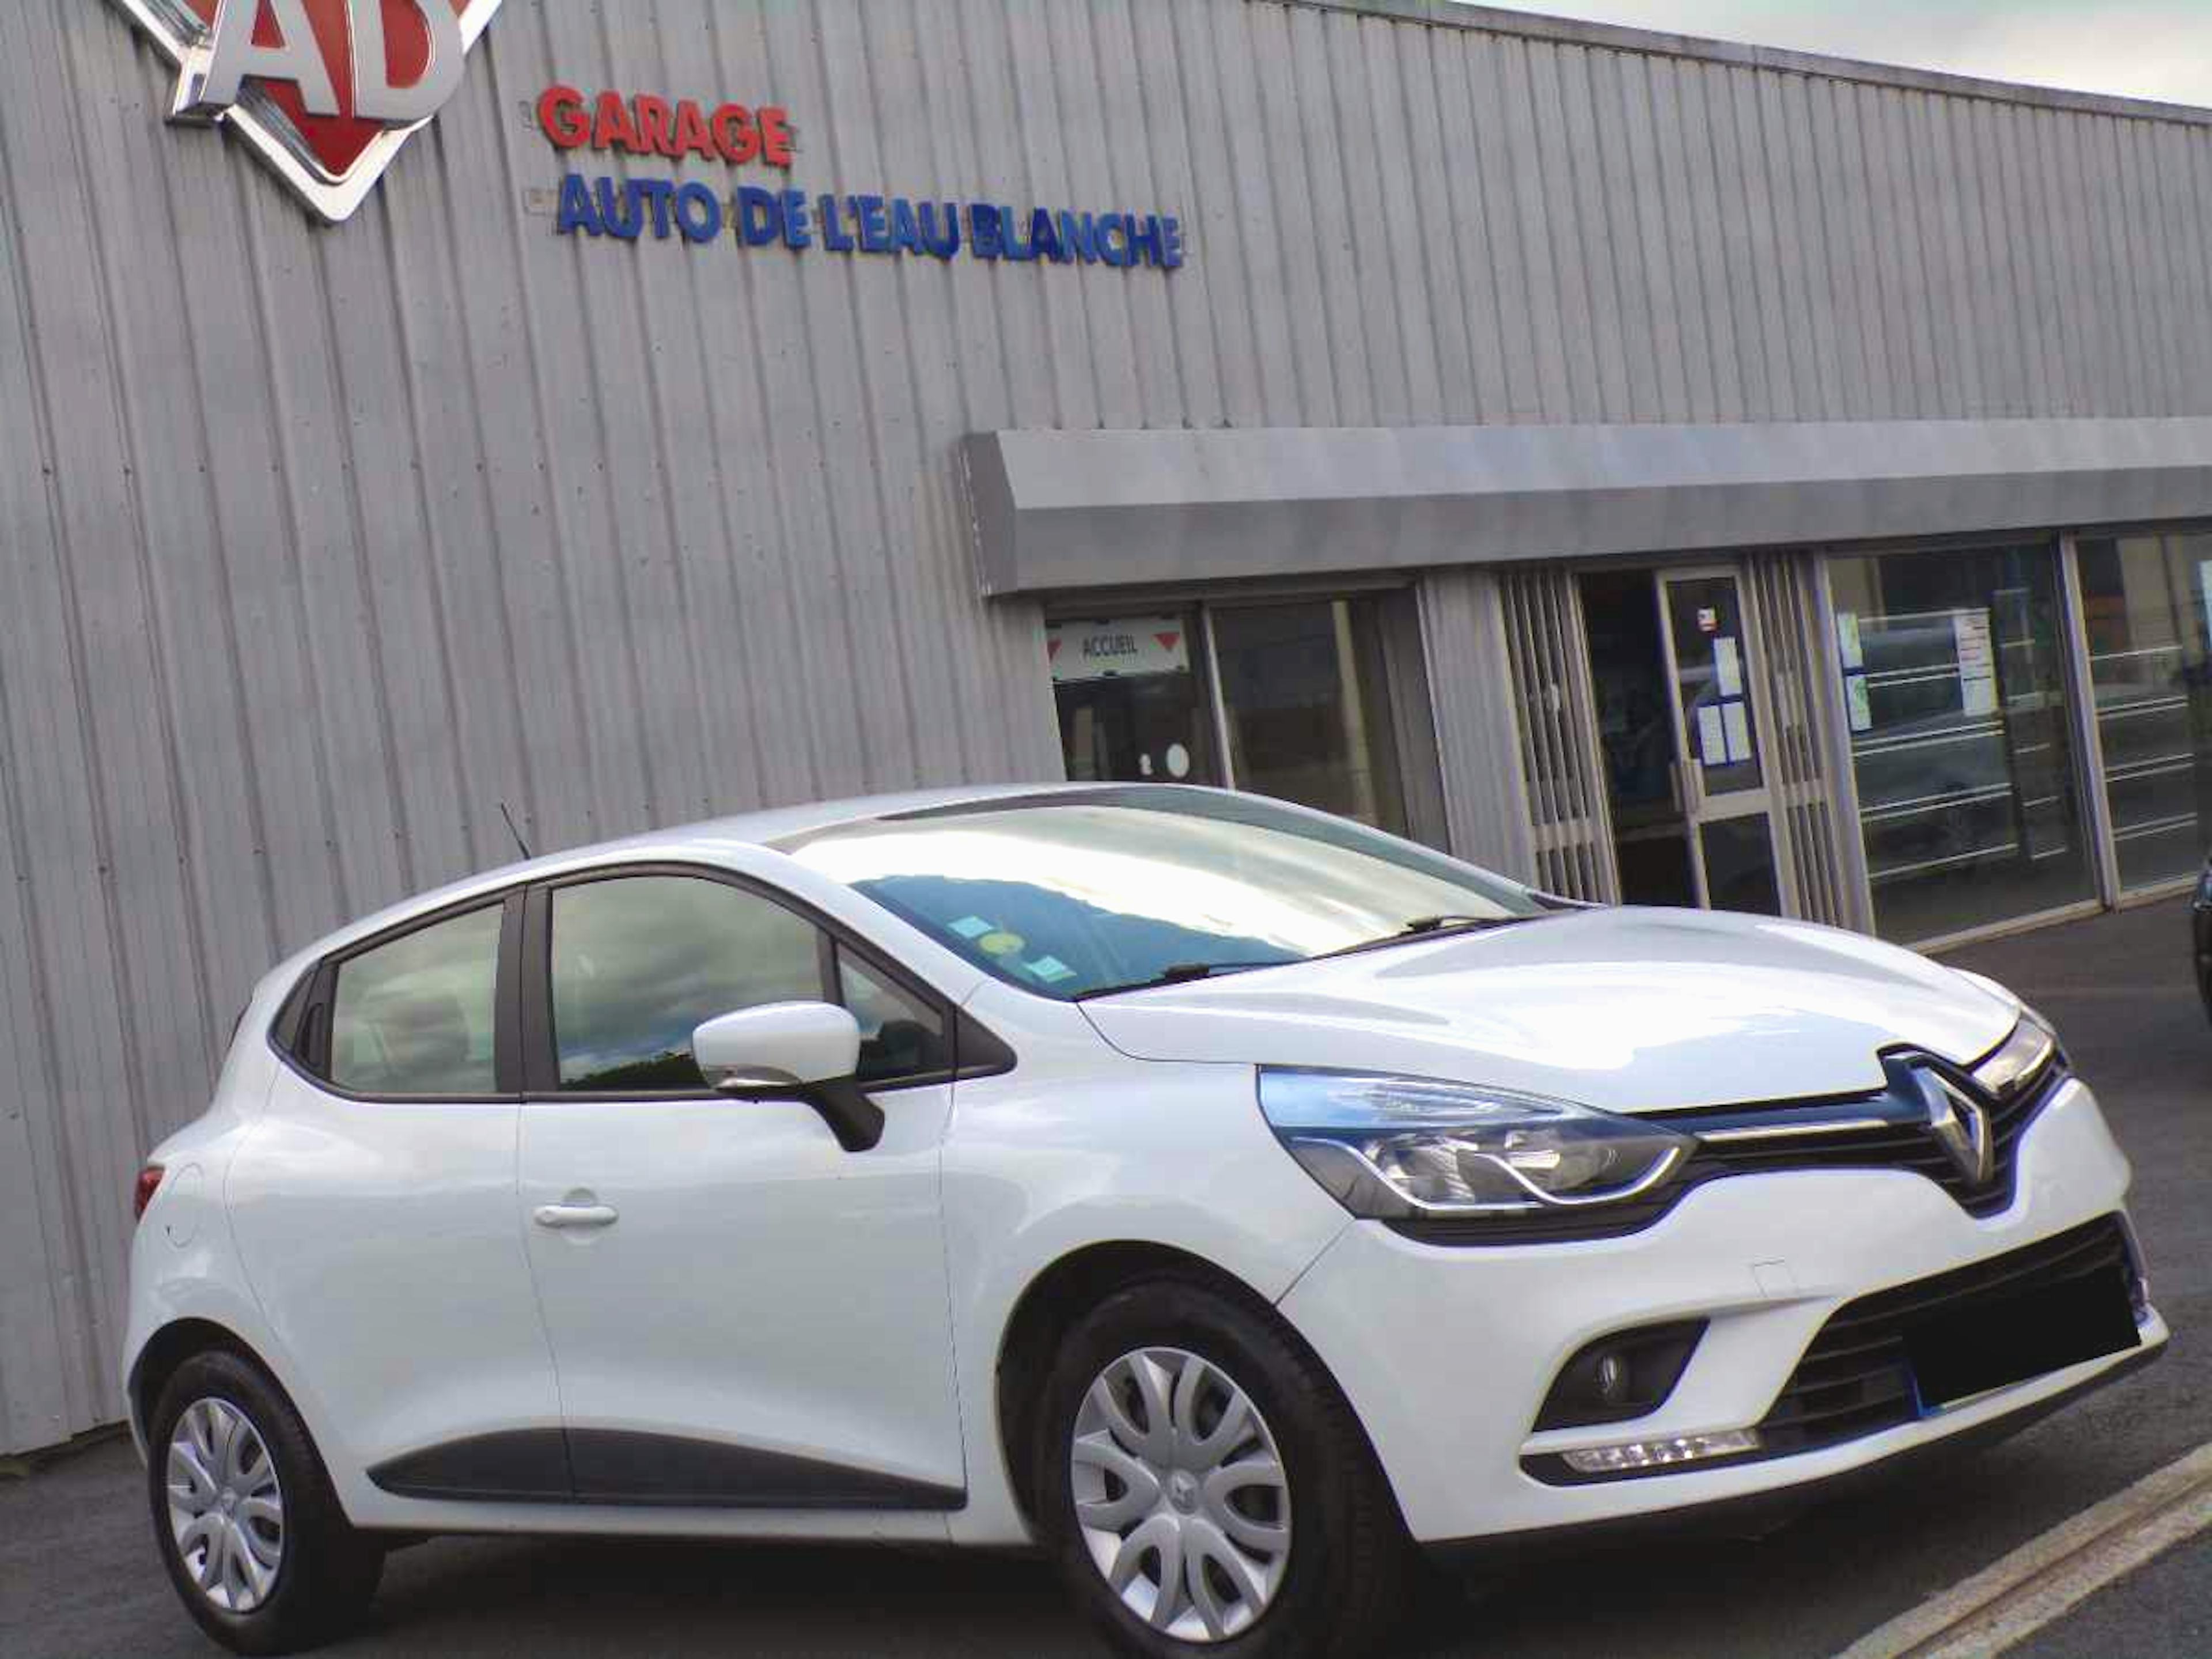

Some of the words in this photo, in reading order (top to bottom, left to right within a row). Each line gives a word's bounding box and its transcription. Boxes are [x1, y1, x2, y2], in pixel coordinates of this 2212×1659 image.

[180, 0, 464, 123] AD
[537, 85, 793, 168] GARAGE
[558, 173, 722, 244] AUTO
[737, 185, 811, 251] DE
[818, 194, 960, 260] L'EAU
[969, 203, 1183, 268] BLANCHE
[1082, 633, 1137, 657] ACCUEIL
